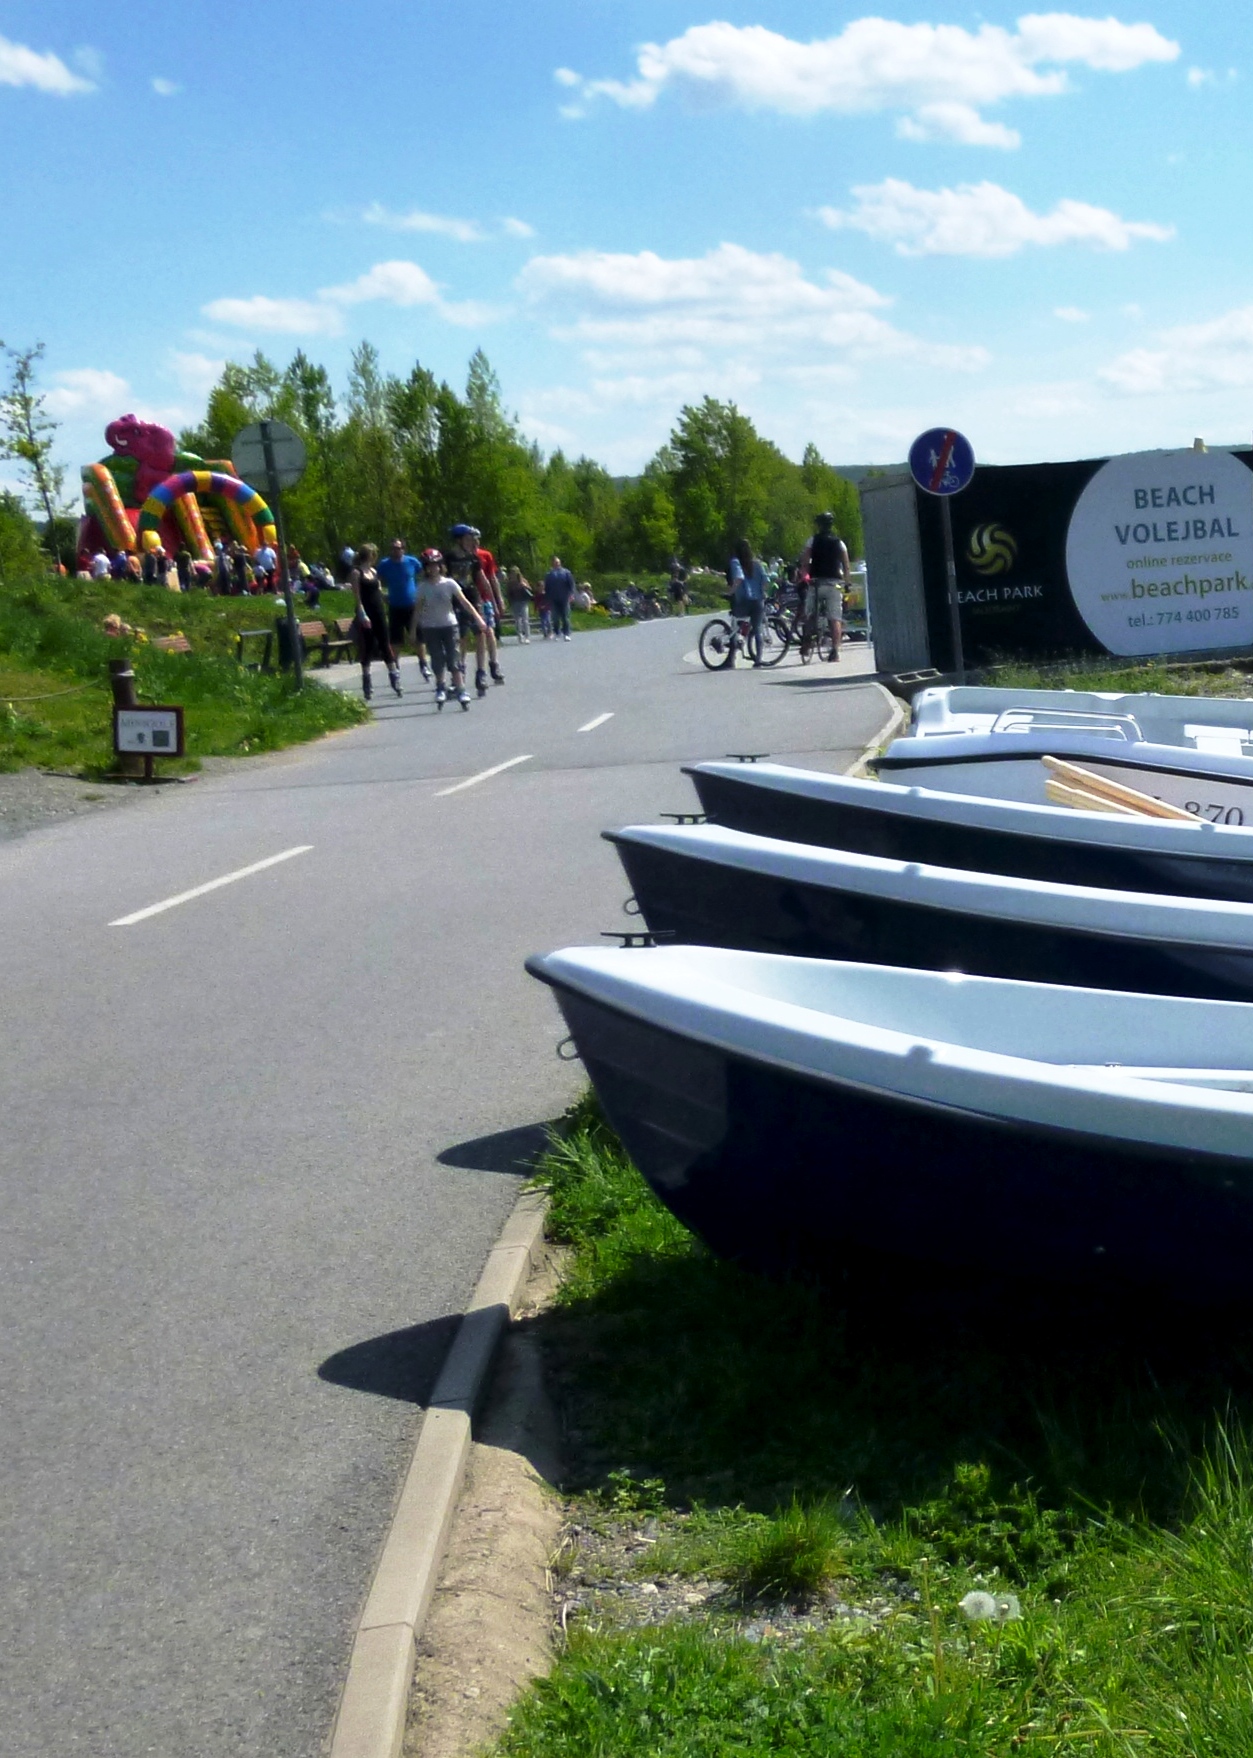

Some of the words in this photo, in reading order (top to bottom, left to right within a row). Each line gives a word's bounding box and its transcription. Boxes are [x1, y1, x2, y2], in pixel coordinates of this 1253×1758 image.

[1133, 484, 1216, 509] BEACH
[1114, 517, 1240, 545] VOLEJBAL
[1126, 555, 1168, 569] online
[1171, 552, 1233, 566] rezervace
[948, 588, 998, 605] EACH
[1003, 585, 1043, 600] PARK
[1157, 611, 1183, 625] 774
[1186, 608, 1212, 623] 400
[1214, 605, 1240, 620] 785
